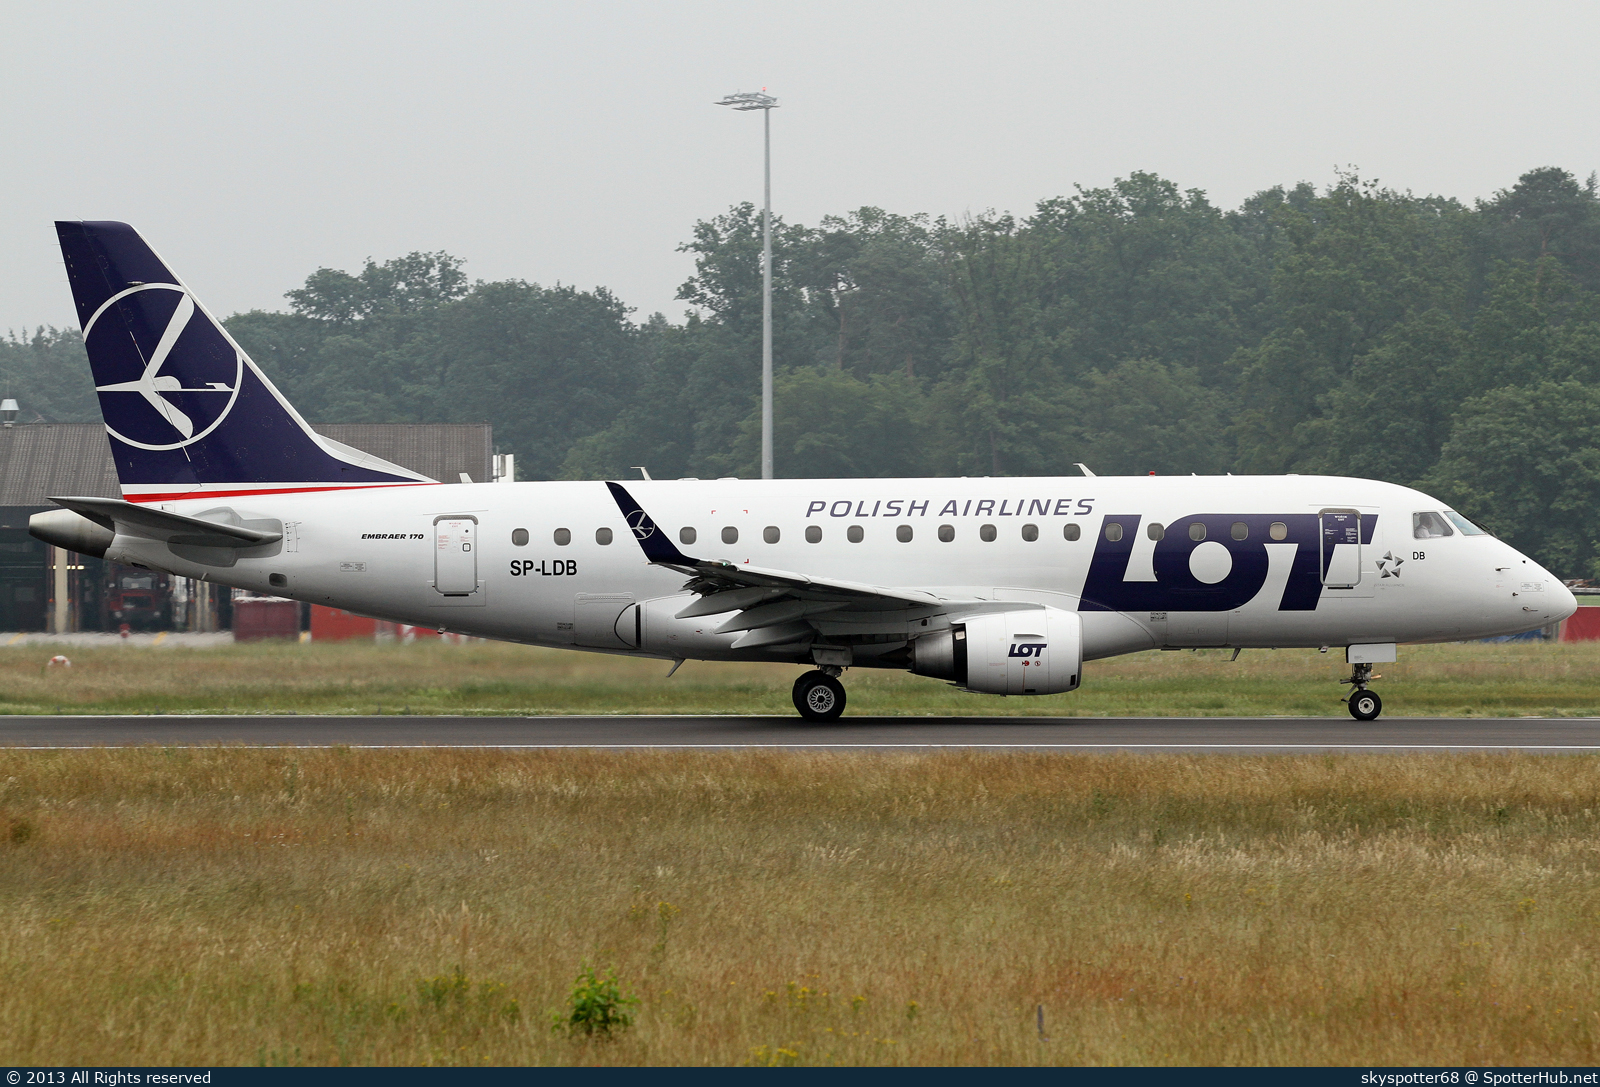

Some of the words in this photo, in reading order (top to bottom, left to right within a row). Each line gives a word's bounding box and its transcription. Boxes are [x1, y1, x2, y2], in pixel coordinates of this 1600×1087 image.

[806, 500, 930, 518] POLISH
[938, 498, 1096, 516] AIRLINES
[1077, 513, 1379, 611] LOT
[1412, 551, 1426, 561] DB
[509, 559, 577, 576] SP-LDB
[1008, 643, 1048, 658] LOT
